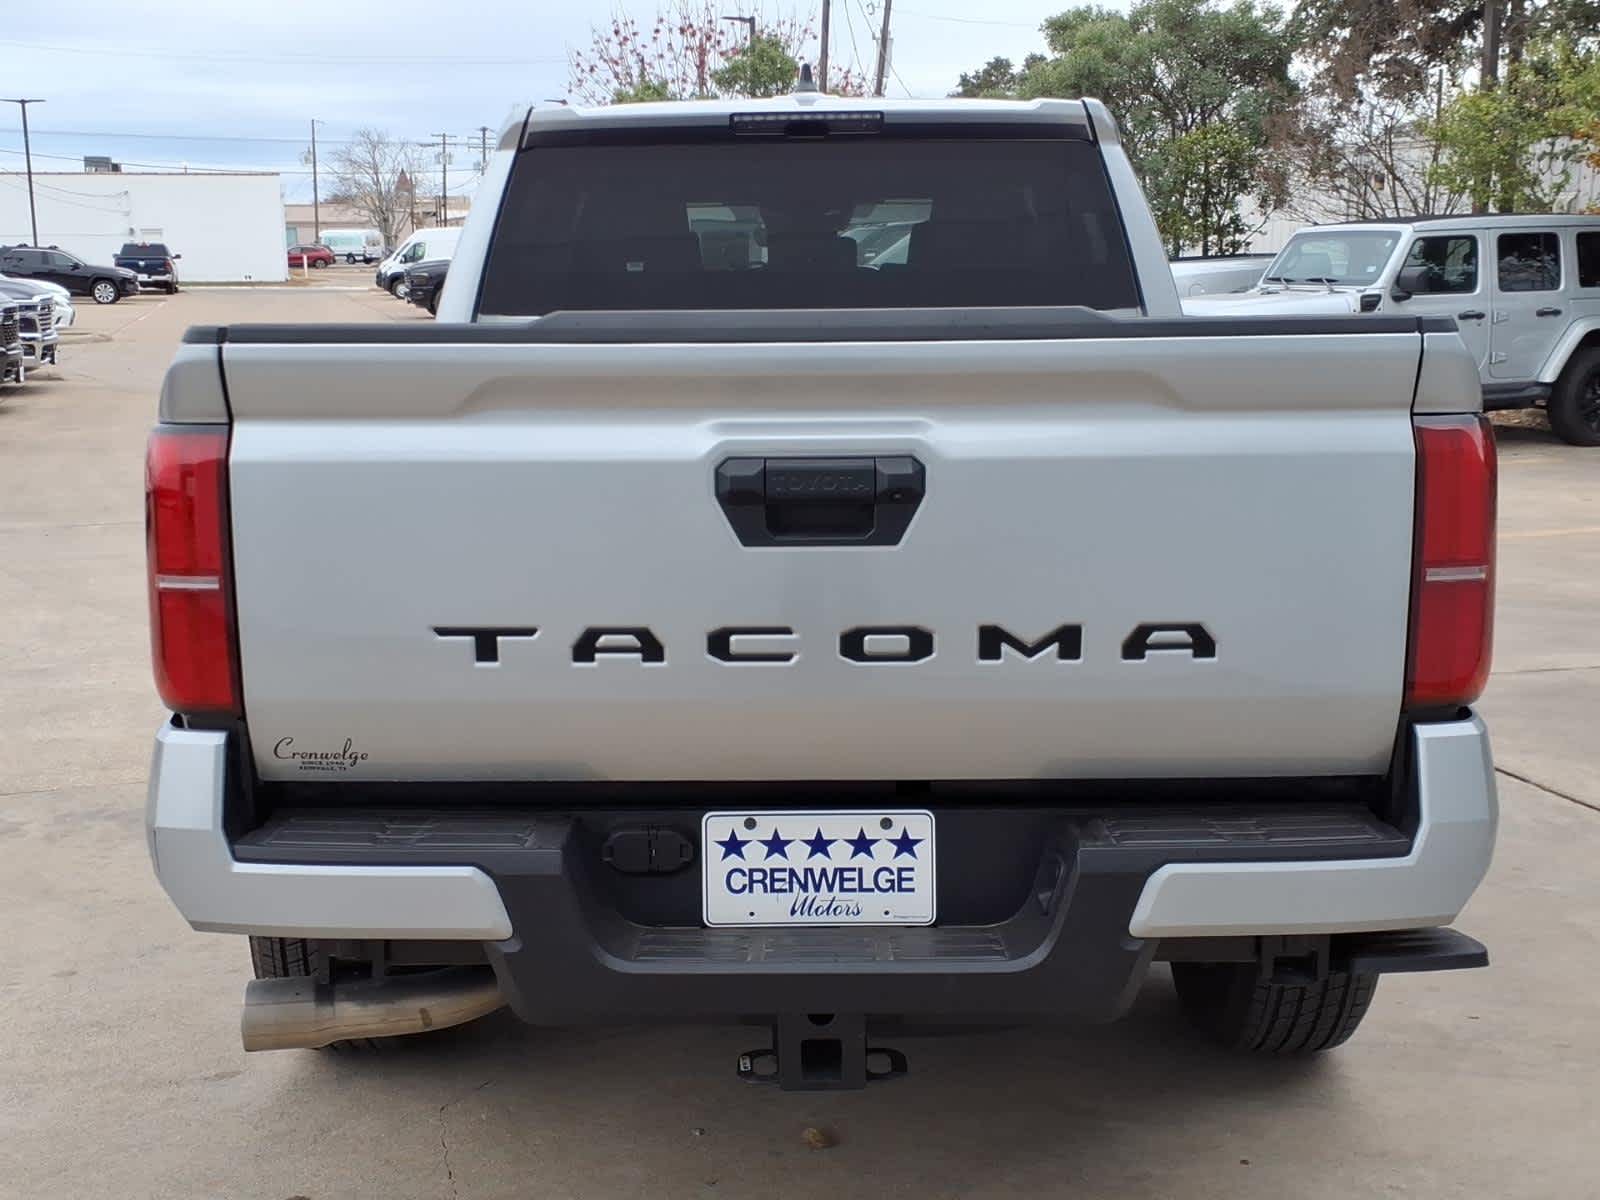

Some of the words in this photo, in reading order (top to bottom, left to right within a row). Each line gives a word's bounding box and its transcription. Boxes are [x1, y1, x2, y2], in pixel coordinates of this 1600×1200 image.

[431, 622, 1217, 666] TACOMA
[273, 736, 369, 768] Crenwelge
[725, 866, 916, 894] CRENWELGE
[785, 890, 864, 917] Motors
